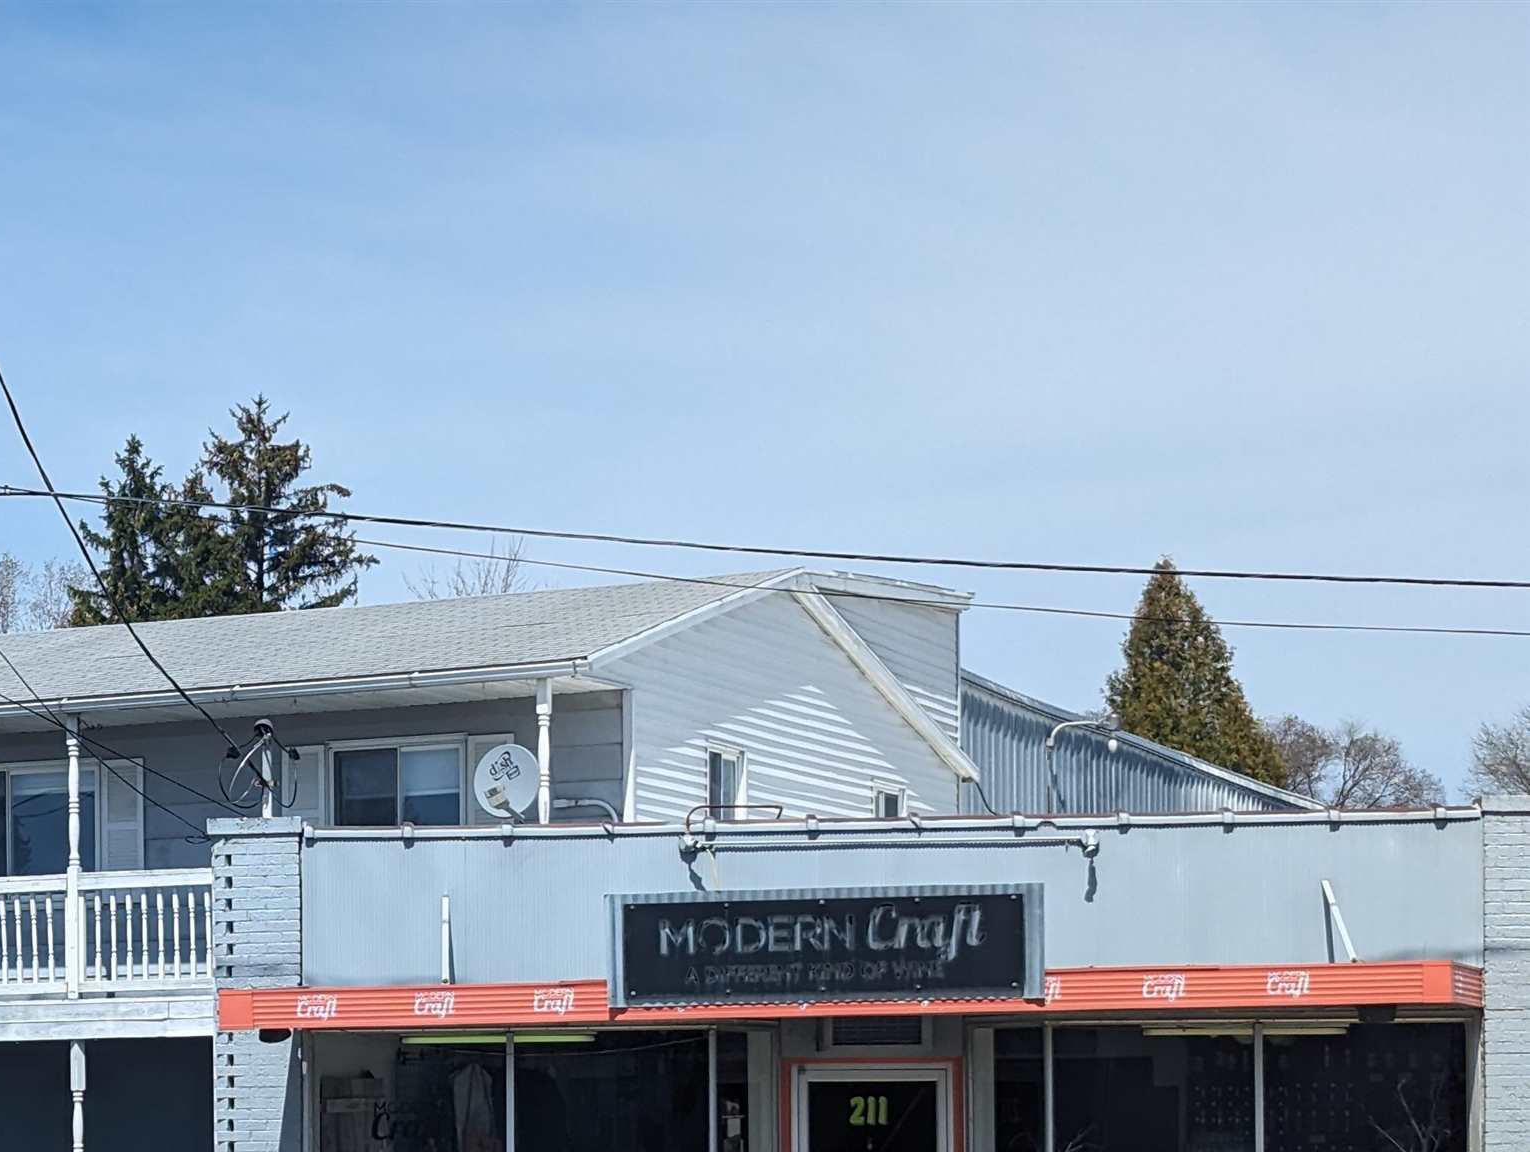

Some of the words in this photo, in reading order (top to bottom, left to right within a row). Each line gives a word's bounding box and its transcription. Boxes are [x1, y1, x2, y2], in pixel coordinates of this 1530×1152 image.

[658, 914, 856, 956] MODERN
[868, 902, 987, 961] Craft
[685, 965, 701, 985] A
[860, 960, 887, 980] OF
[1142, 981, 1185, 1001] Craft
[1267, 976, 1310, 998] Craft
[296, 999, 338, 1020] Craft
[413, 998, 455, 1018] Craft
[533, 994, 575, 1015] Craft
[849, 1095, 889, 1126] 211
